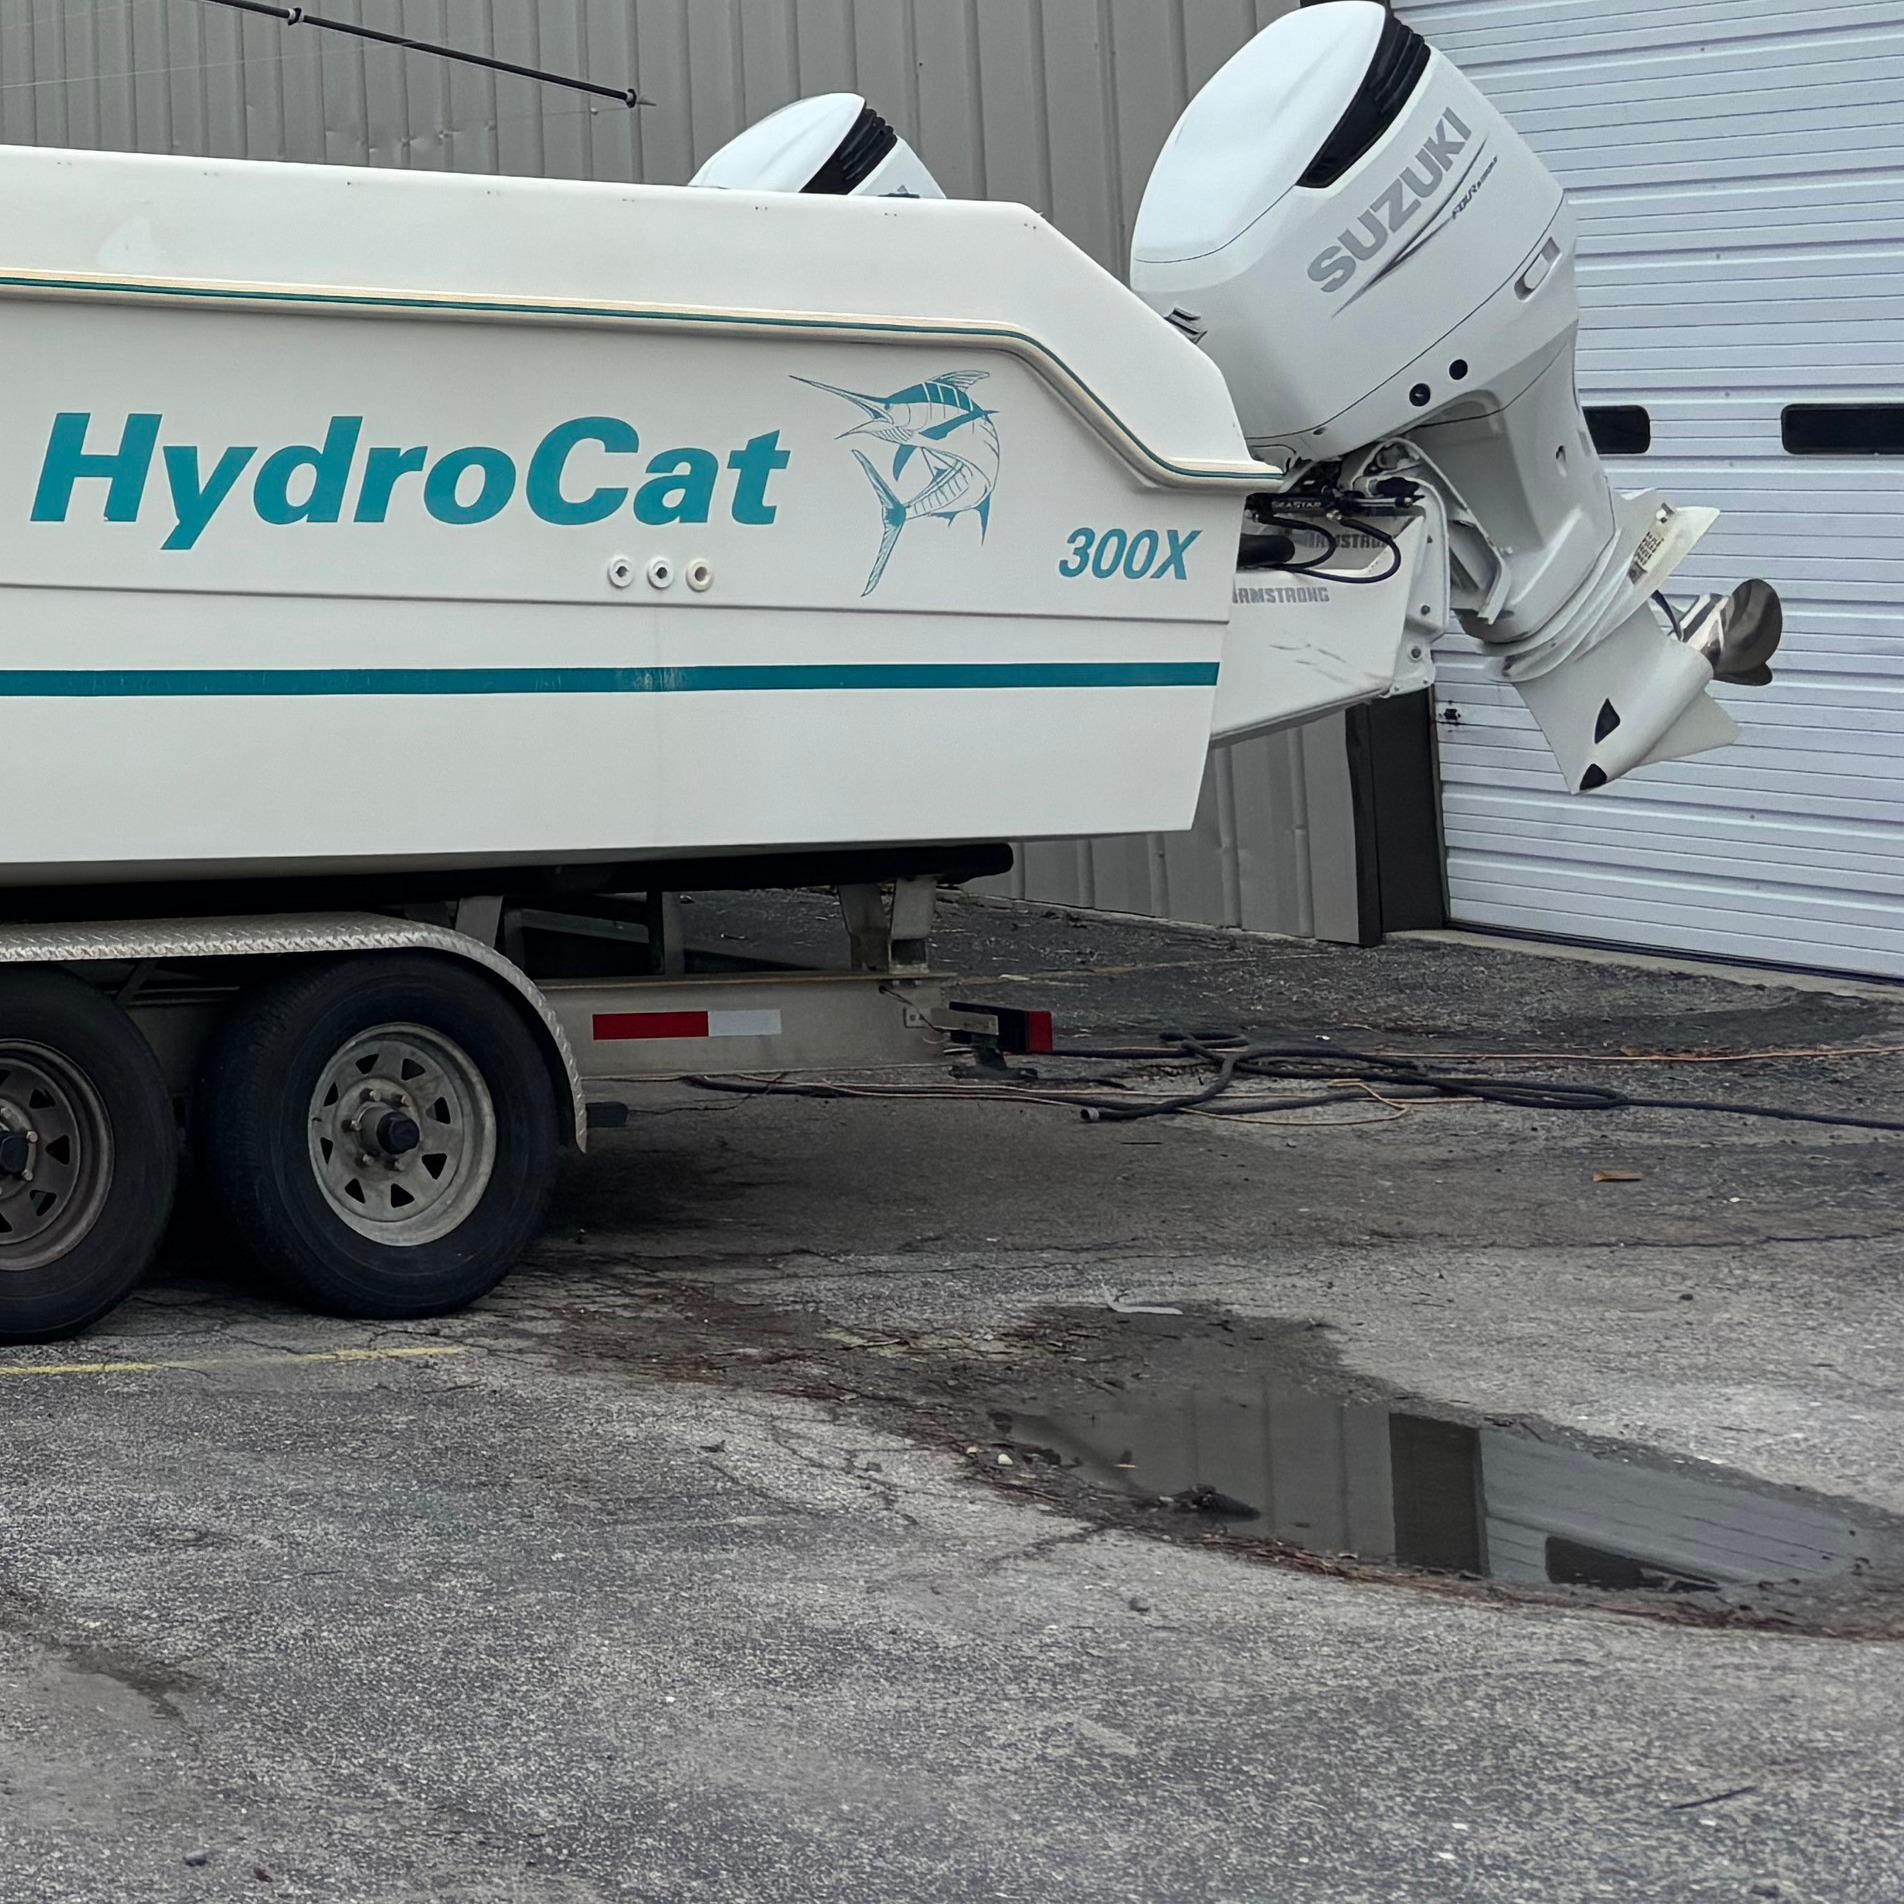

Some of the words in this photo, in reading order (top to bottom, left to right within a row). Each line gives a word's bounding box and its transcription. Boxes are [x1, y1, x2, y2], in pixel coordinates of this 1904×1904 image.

[1306, 106, 1472, 293] SUZUKI
[30, 411, 791, 552] HydroCat
[1058, 527, 1203, 581] 300X
